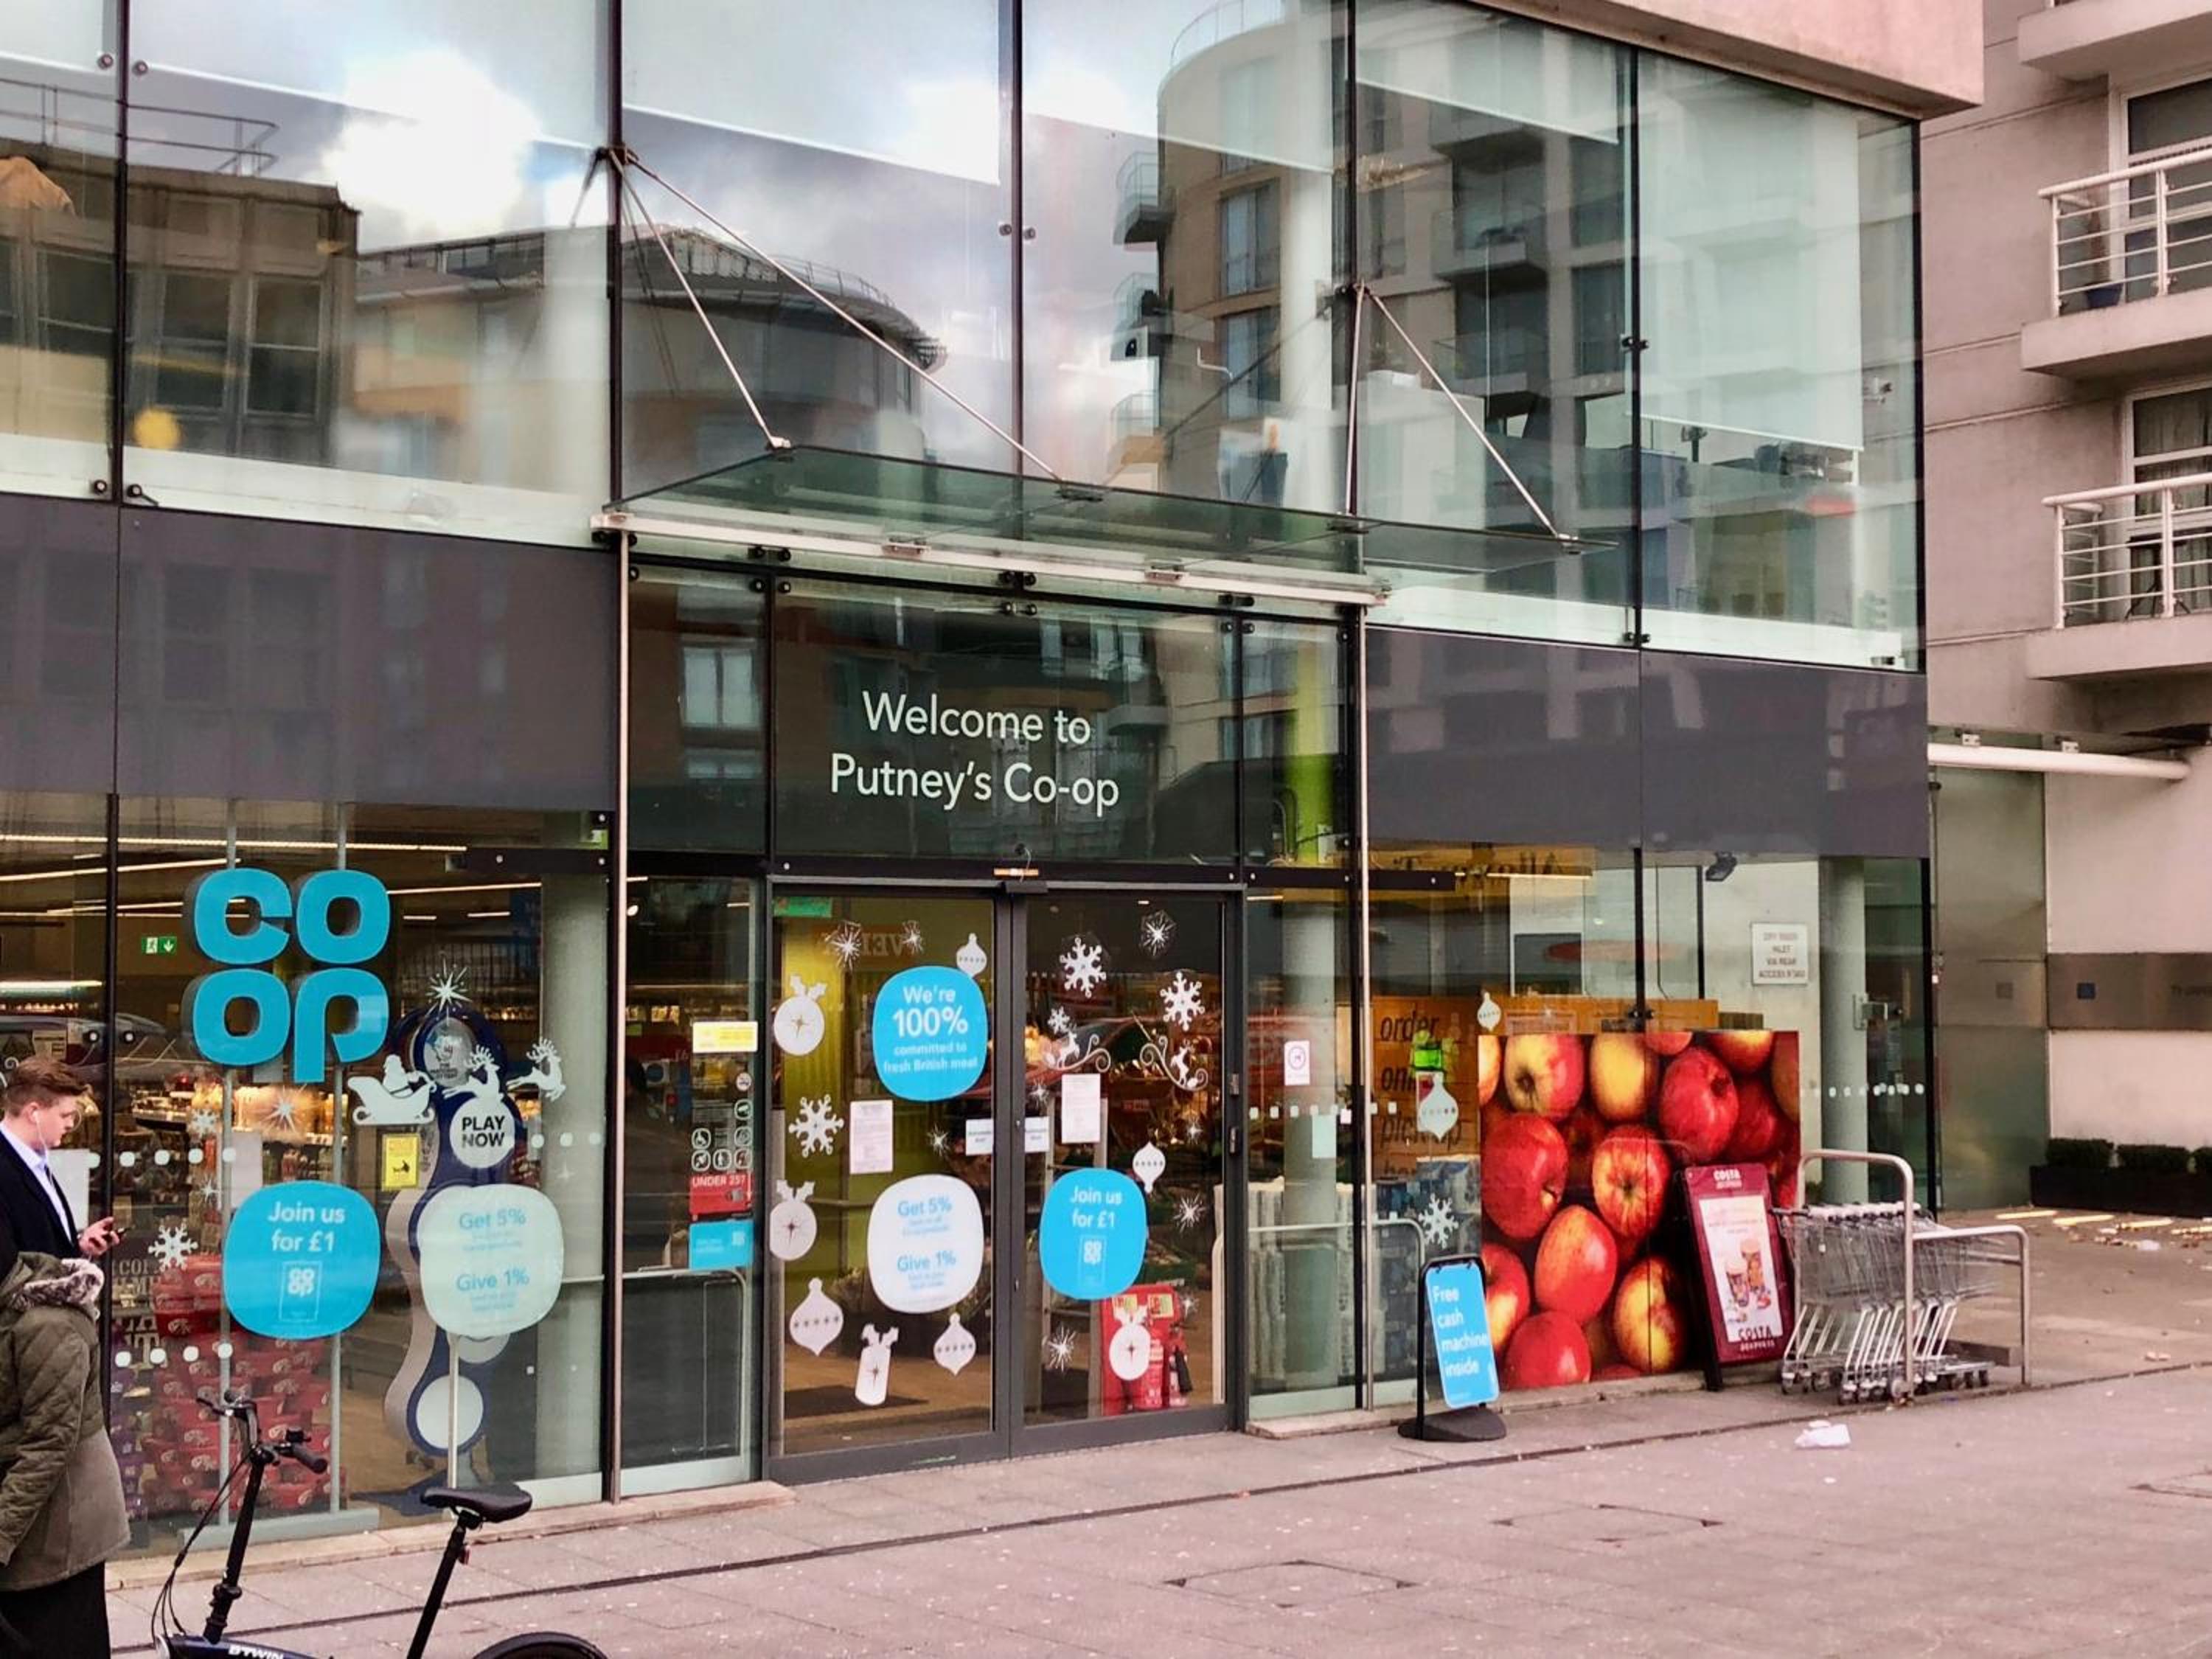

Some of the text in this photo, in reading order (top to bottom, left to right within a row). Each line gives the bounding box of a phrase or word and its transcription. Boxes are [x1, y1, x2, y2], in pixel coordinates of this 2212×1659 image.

[863, 691, 1091, 745] Welcome to
[831, 754, 1119, 817] Putney's Co-op
[903, 986, 956, 1004] We're
[892, 1005, 969, 1037] 100%
[1380, 1010, 1439, 1043] order
[894, 1041, 968, 1057] committed to
[884, 1056, 978, 1074] fresh British meat
[462, 1116, 506, 1131] PLAY
[462, 1133, 506, 1148] NOW
[691, 1174, 727, 1188] UNDER
[1713, 1169, 1741, 1181] COSTA
[897, 1194, 954, 1217] Get 5%
[1071, 1185, 1124, 1206] Join us
[267, 1200, 346, 1224] Join us
[459, 1208, 526, 1230] Get 5%
[1072, 1208, 1116, 1228] for £1
[271, 1228, 335, 1252] for £1
[897, 1250, 957, 1273] Give 1%
[456, 1267, 531, 1292] Give 1%
[1433, 1285, 1460, 1303] Free
[1437, 1308, 1464, 1327] cash
[1441, 1331, 1489, 1352] machine
[1738, 1325, 1773, 1343] COSTA
[1444, 1356, 1481, 1377] inside
